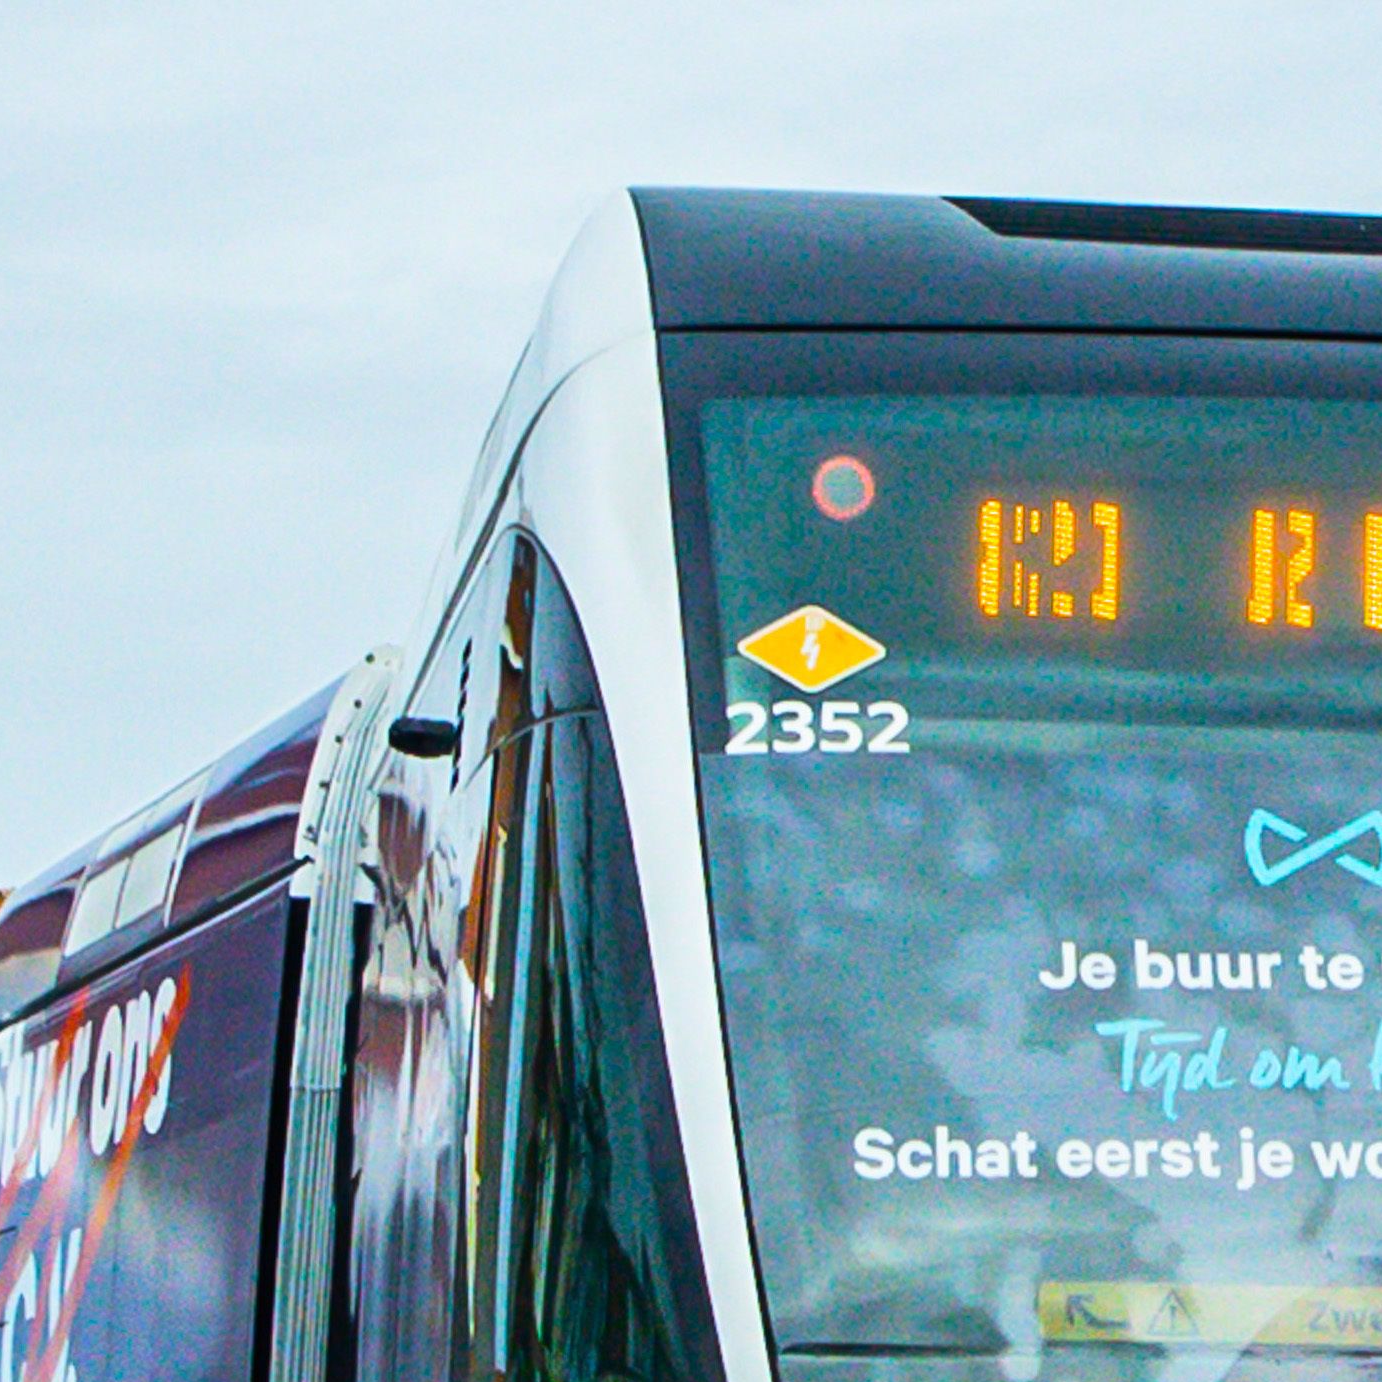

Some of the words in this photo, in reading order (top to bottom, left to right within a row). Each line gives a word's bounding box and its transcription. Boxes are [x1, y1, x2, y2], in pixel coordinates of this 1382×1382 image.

[725, 700, 911, 755] 2352
[1038, 941, 1116, 990] Je
[1134, 938, 1282, 990] buur
[1299, 944, 1365, 990] te
[1249, 1045, 1350, 1092] om
[853, 1126, 1038, 1180] Schat
[1056, 1131, 1221, 1179] eerst
[1236, 1126, 1295, 1190] je
